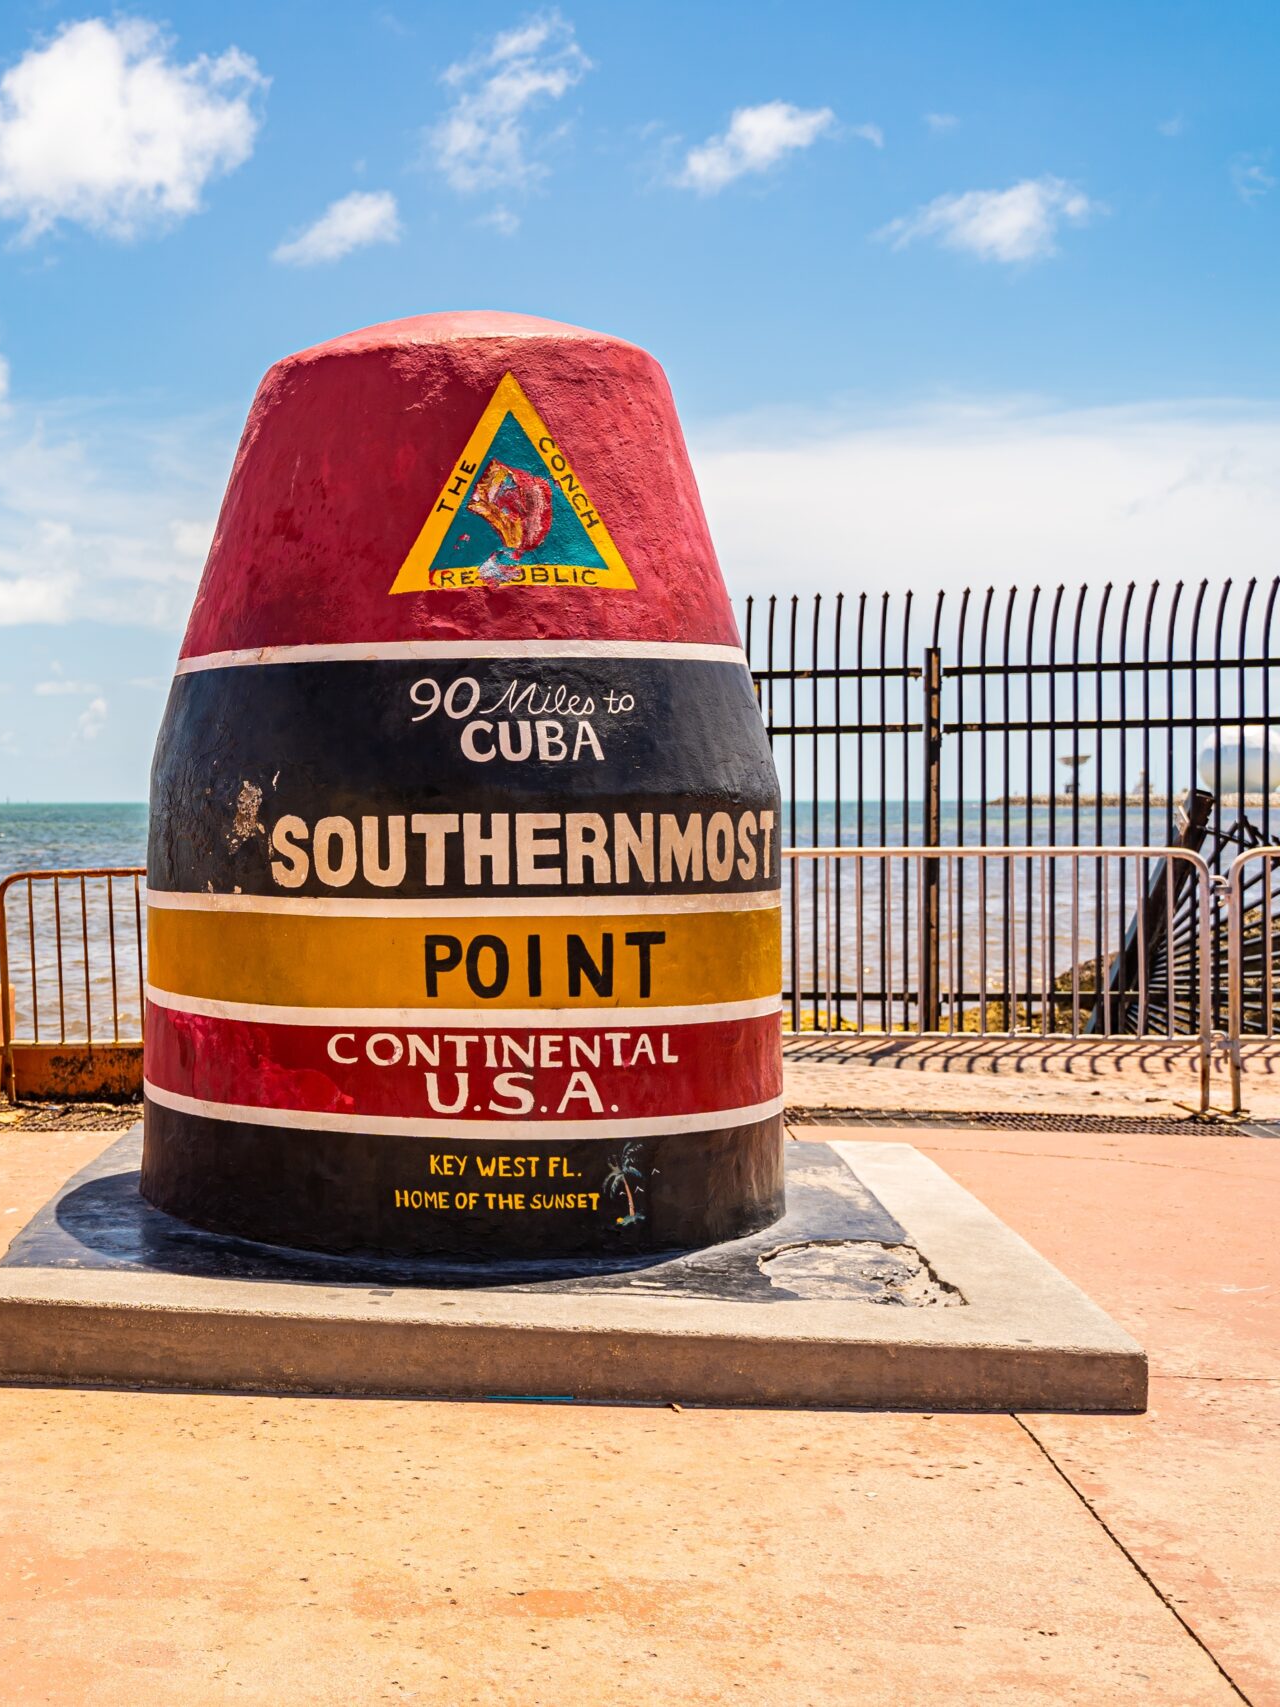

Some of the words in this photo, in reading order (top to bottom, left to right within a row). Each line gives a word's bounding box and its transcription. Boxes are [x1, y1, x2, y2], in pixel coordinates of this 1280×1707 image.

[437, 462, 477, 513] THE
[538, 436, 600, 529] CONCH
[440, 567, 598, 587] REUBLIC
[409, 677, 481, 722] 90
[479, 680, 596, 715] Miles
[603, 689, 635, 714] to
[460, 720, 605, 763] CUBA
[270, 810, 775, 888] SOUTHERNMOST
[424, 931, 666, 999] POINT
[327, 1032, 679, 1069] CONTINENTAL
[424, 1071, 620, 1115] U.S.A.
[429, 1154, 468, 1177] KEY
[476, 1156, 540, 1178] WEST
[548, 1157, 583, 1178] FL.
[394, 1189, 450, 1210] HOME
[454, 1192, 480, 1210] OF
[483, 1192, 525, 1210] THE
[529, 1192, 601, 1211] SUNSET
